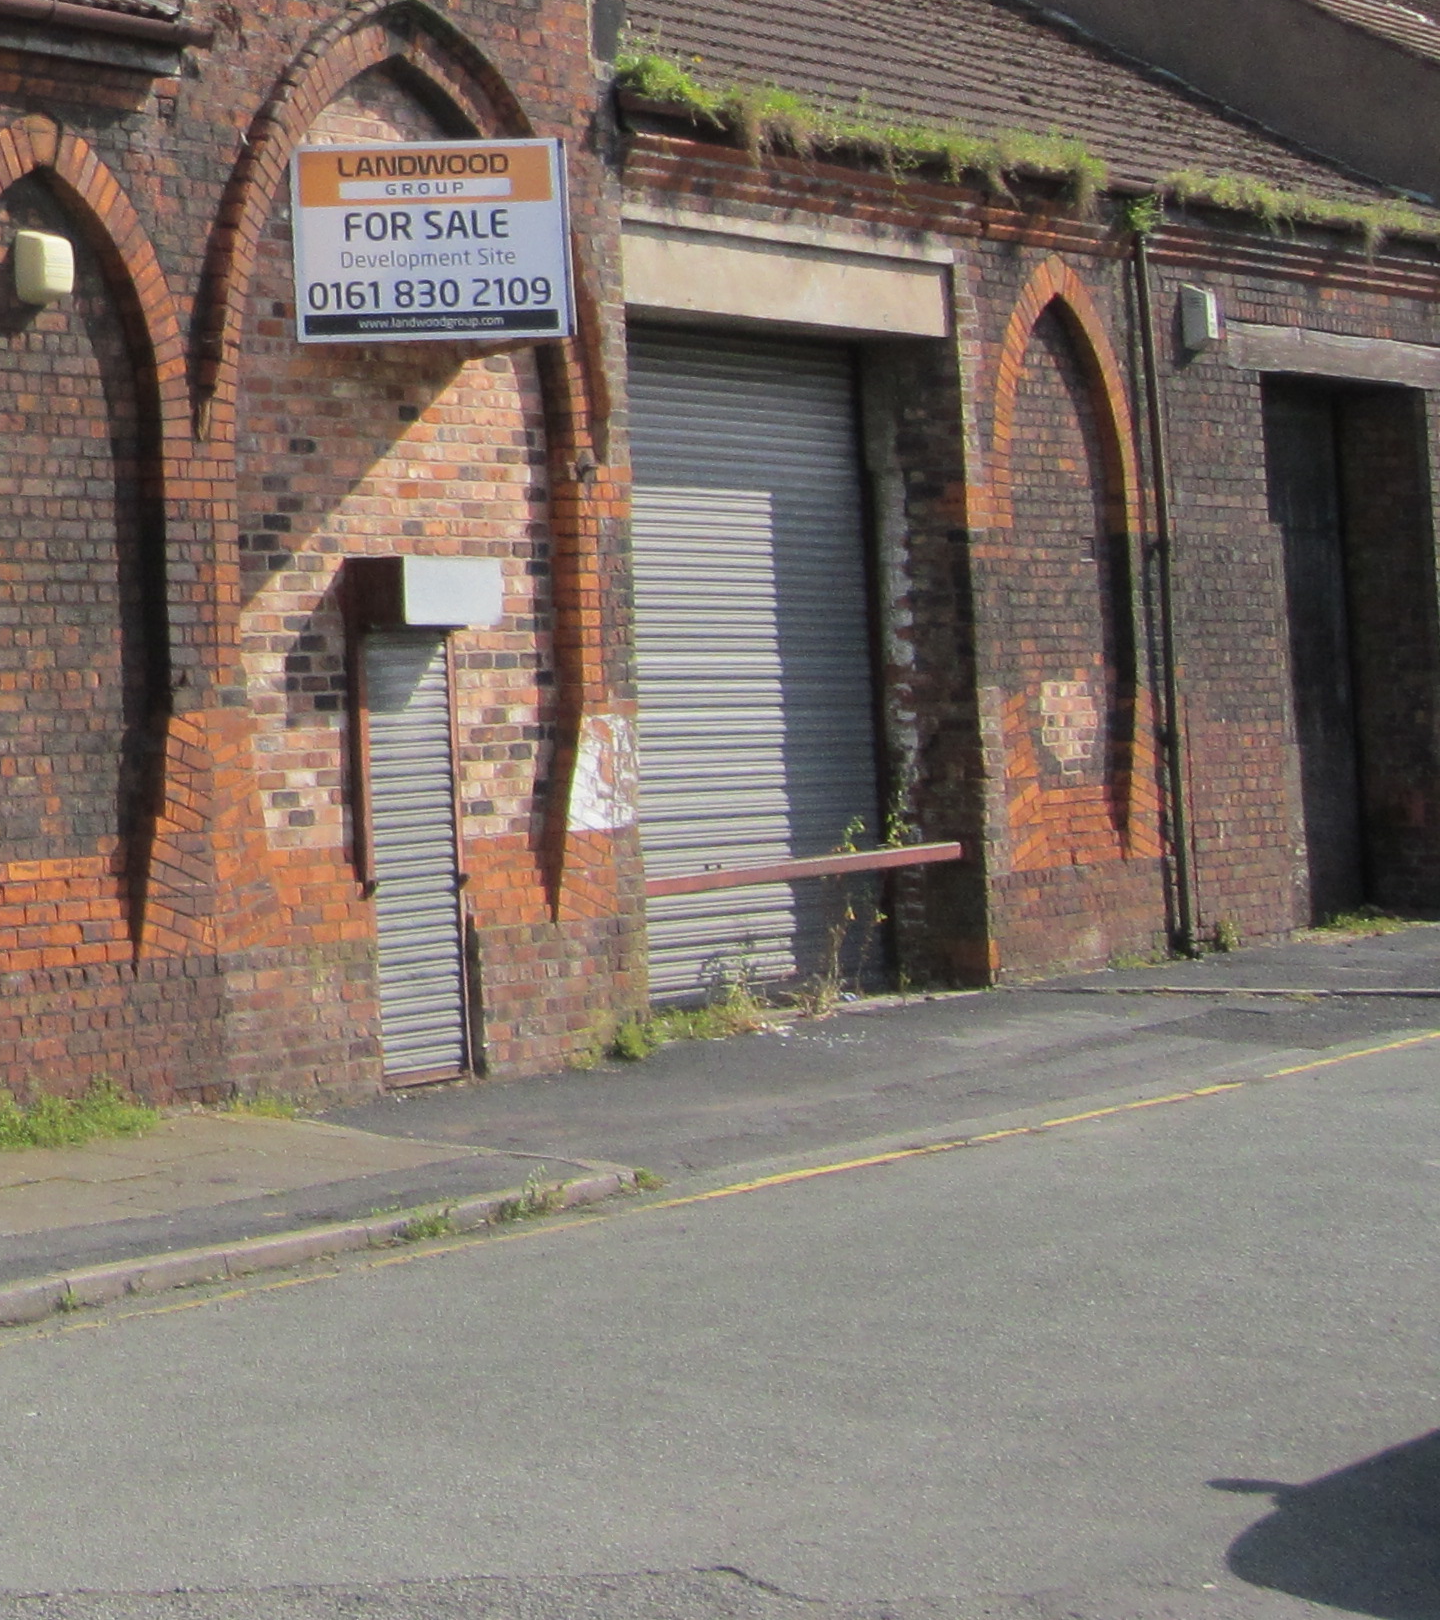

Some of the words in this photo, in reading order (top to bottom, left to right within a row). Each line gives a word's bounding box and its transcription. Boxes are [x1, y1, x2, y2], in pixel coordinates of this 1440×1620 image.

[337, 153, 509, 177] LANDWOOD
[385, 181, 464, 196] GROUP
[344, 211, 413, 241] FOR
[423, 209, 509, 240] SALE
[340, 249, 471, 270] Development
[478, 247, 516, 266] Site
[308, 281, 381, 311] 0161
[394, 279, 460, 308] 830
[472, 277, 552, 306] 2109
[358, 315, 504, 329] www.landwoodgroup.com
